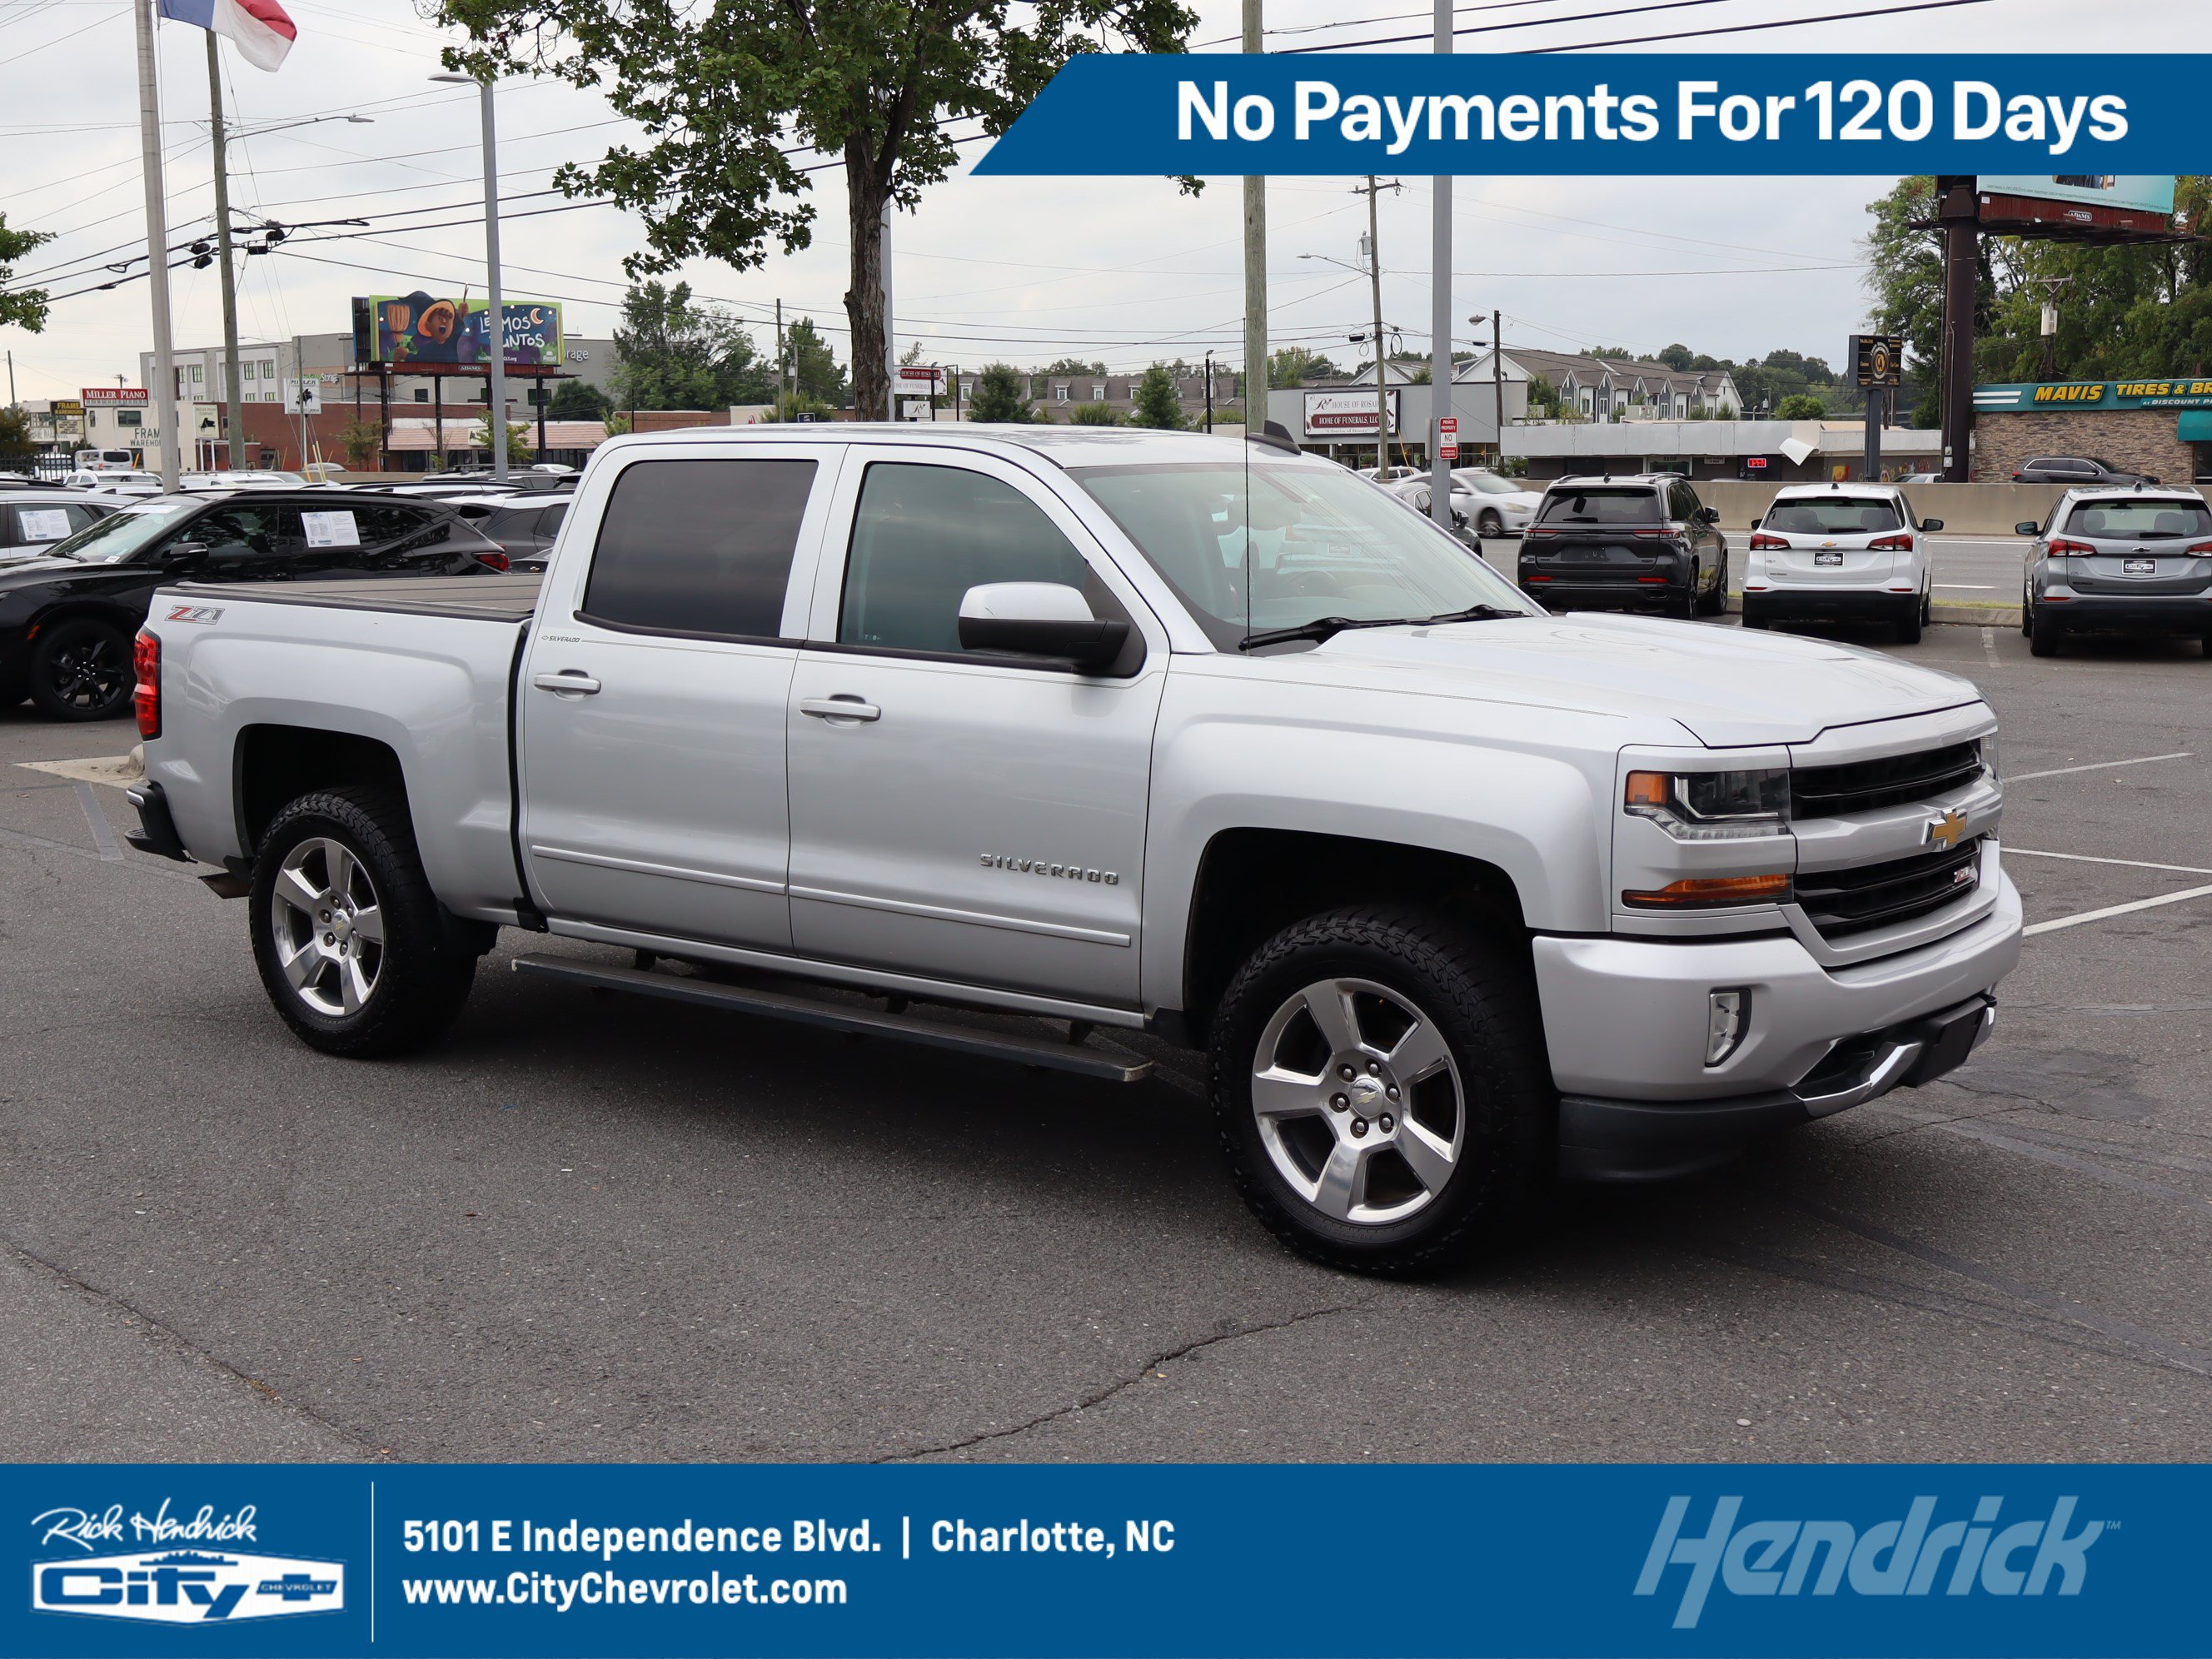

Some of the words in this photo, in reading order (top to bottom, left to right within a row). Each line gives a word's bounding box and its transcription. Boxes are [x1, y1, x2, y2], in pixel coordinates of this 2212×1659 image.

[2070, 212, 2091, 220] ADAMS
[480, 316, 531, 334] LEMOS
[489, 333, 546, 348] UNTOS
[86, 389, 117, 399] MILLER
[120, 389, 147, 400] PIANO
[2034, 384, 2105, 401] MAVIS
[2115, 383, 2171, 396] TIRES
[2174, 384, 2185, 395] &
[1332, 400, 1351, 409] HOUSE
[1351, 400, 1360, 408] OF
[1319, 416, 1334, 425] HOME
[1342, 416, 1368, 425] FUNERALS,
[134, 427, 160, 440] FRAM
[1444, 433, 1452, 442] NO
[130, 439, 161, 447] WAREHO
[164, 604, 226, 625] Z71
[979, 853, 1119, 885] SILVERADO
